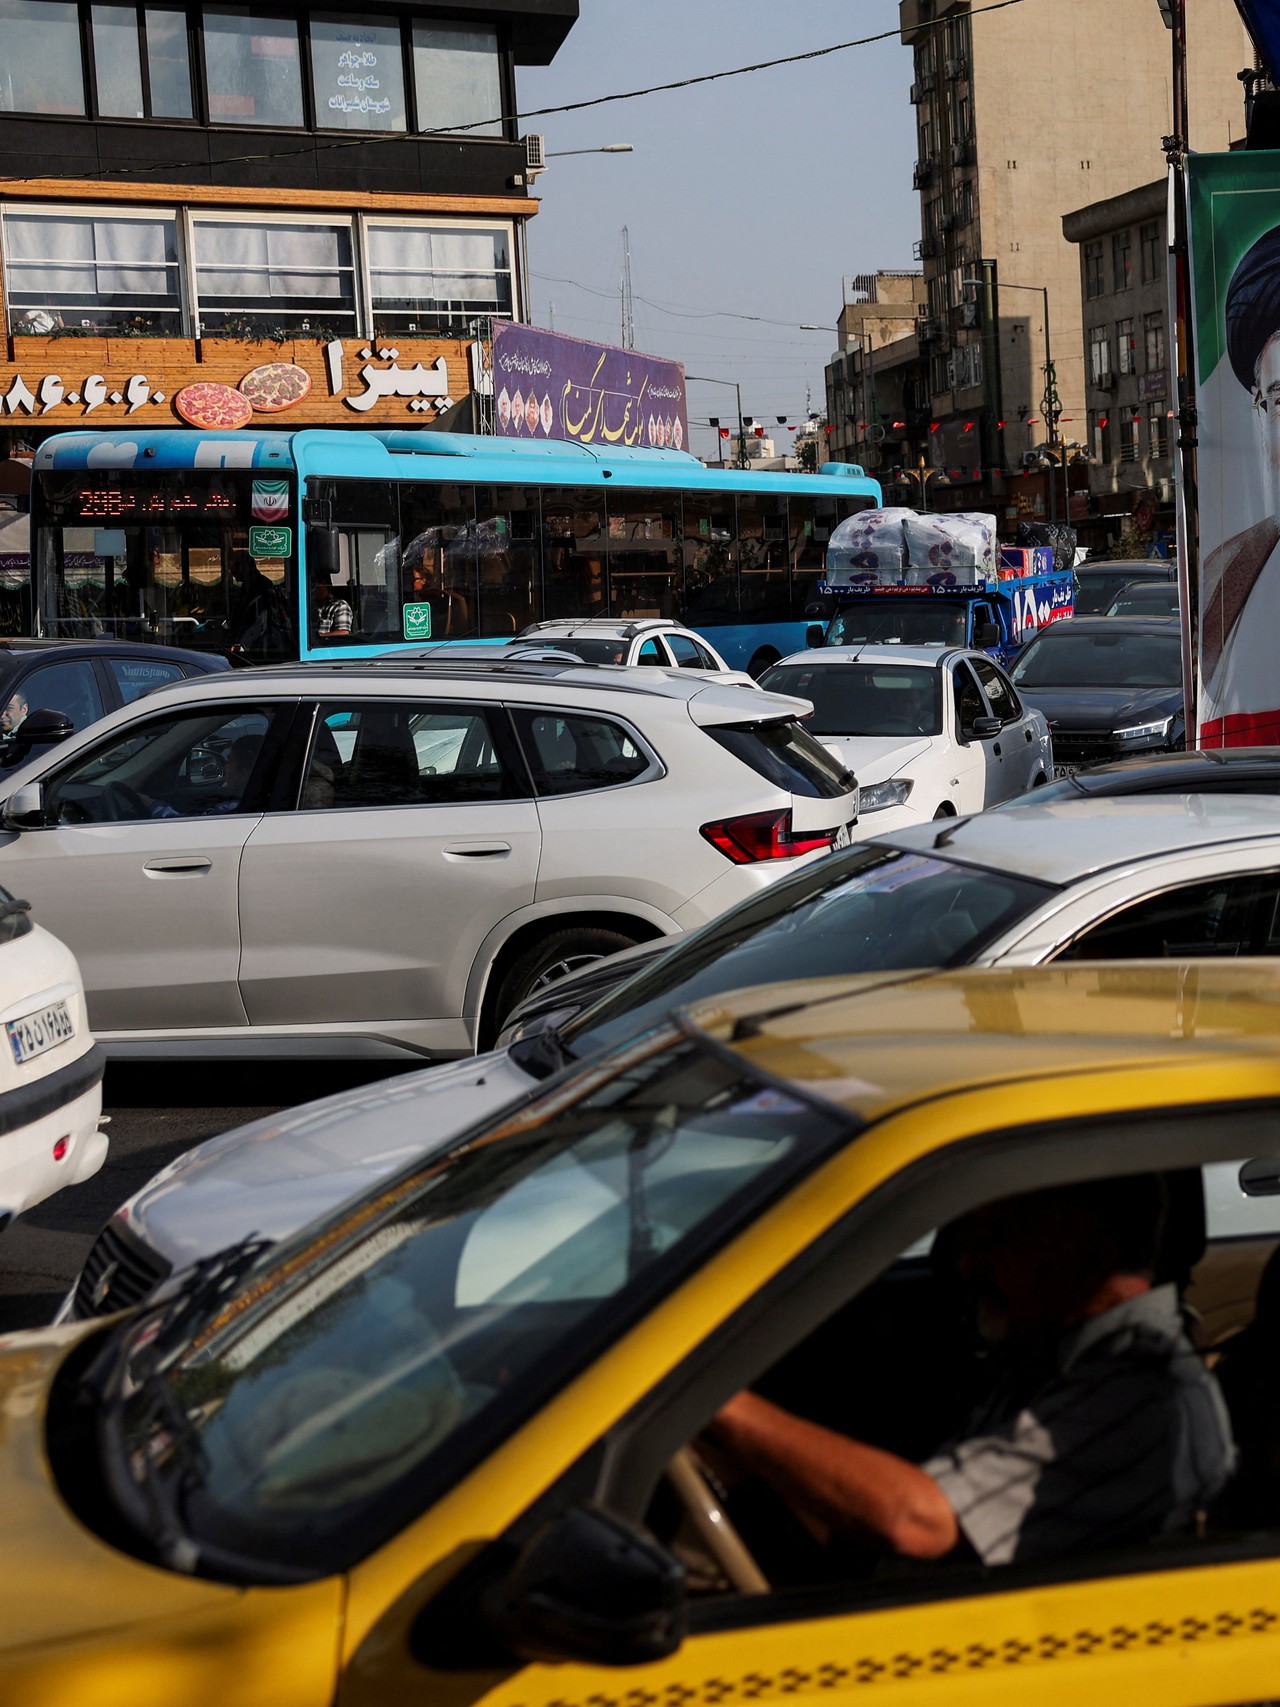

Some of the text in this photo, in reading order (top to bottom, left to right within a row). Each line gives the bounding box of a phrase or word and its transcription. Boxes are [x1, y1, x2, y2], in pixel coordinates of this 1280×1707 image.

[327, 339, 455, 416] پیتزا
[0, 374, 167, 415] ۸۶۰۶۰۶۰
[819, 586, 844, 594] ۱۵۰۰
[931, 585, 957, 594] ۱۵۰۰
